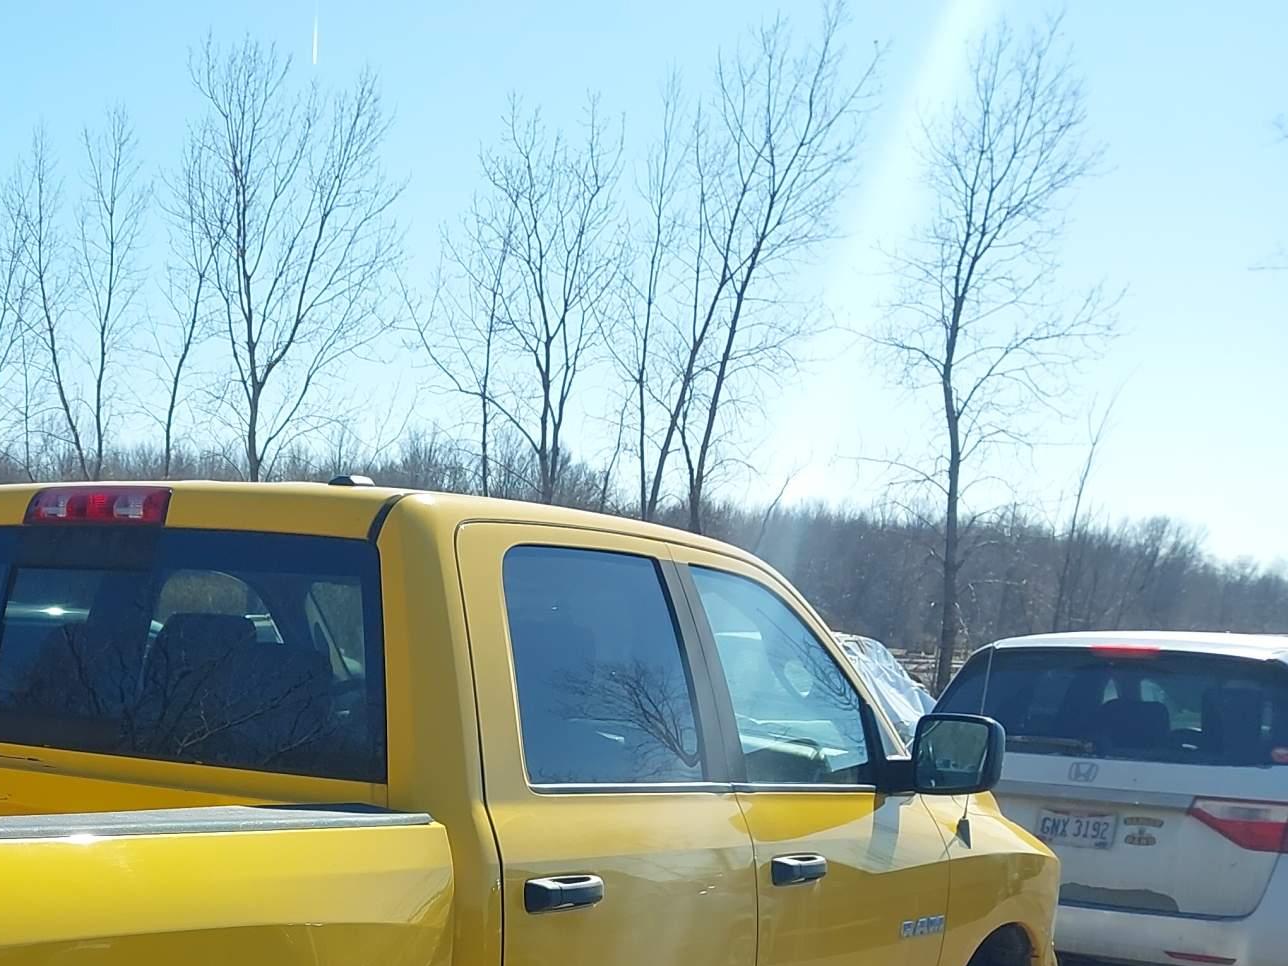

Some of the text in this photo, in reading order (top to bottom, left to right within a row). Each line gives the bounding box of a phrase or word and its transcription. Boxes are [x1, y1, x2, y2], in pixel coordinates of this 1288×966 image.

[1040, 817, 1070, 838] GNX
[1073, 820, 1109, 840] 3192
[899, 914, 945, 938] RAM
